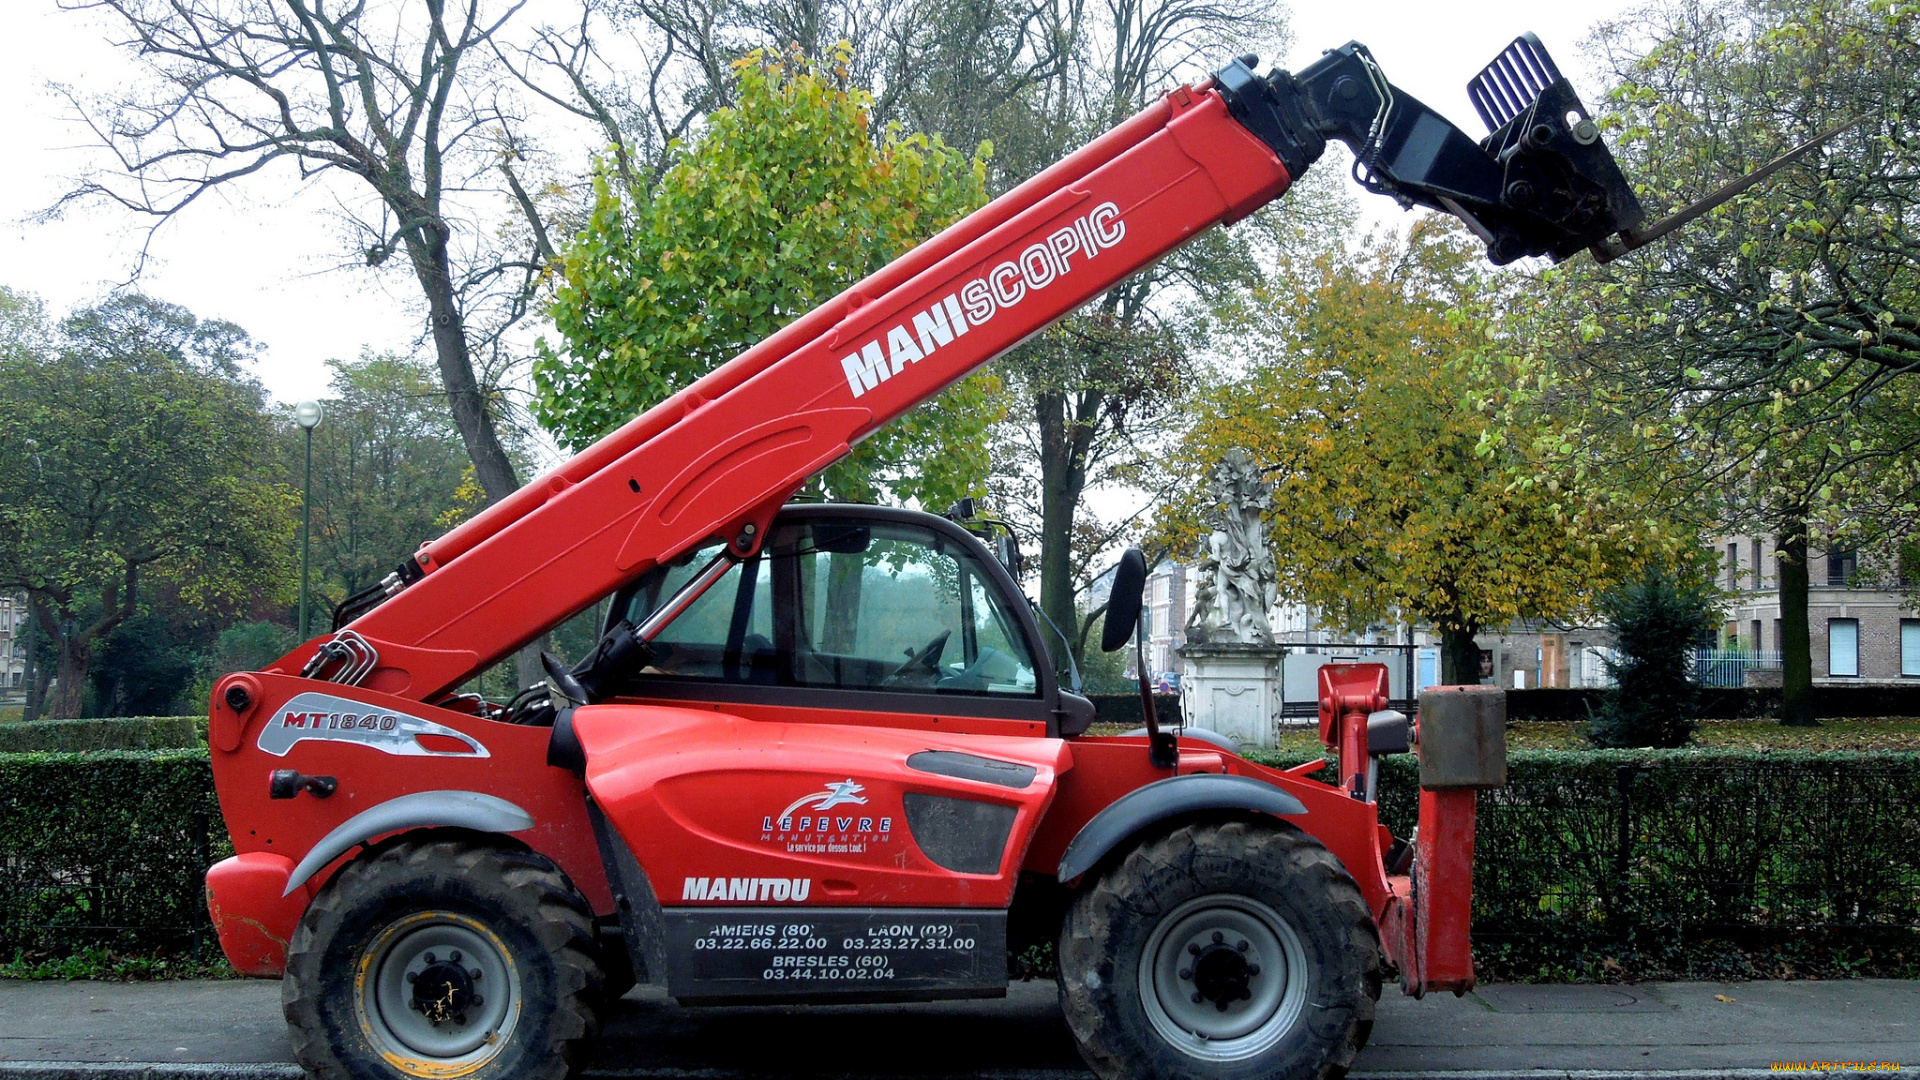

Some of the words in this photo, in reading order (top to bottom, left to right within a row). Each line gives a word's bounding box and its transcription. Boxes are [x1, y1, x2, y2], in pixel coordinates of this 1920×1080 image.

[840, 201, 1126, 399] MANISCOPIC
[281, 711, 397, 731] MT1840
[762, 816, 892, 832] LEFEVRE
[760, 834, 889, 843] MANUTENTION
[786, 842, 795, 852] Le
[795, 843, 816, 853] service
[817, 844, 826, 854] par
[828, 843, 848, 853] dessus
[849, 843, 862, 853] tout
[682, 877, 811, 901] MANITOU
[709, 924, 776, 936] AMIENS
[782, 924, 815, 938] (80)
[868, 925, 914, 937] LAON
[920, 925, 953, 938] (02)
[695, 938, 828, 950] 03.22.66.22.00
[843, 938, 976, 950] 03.23.27.31.00
[772, 956, 849, 967] BRESLES
[855, 956, 889, 968] (60)
[763, 968, 895, 980] 03.44.10.02.04
